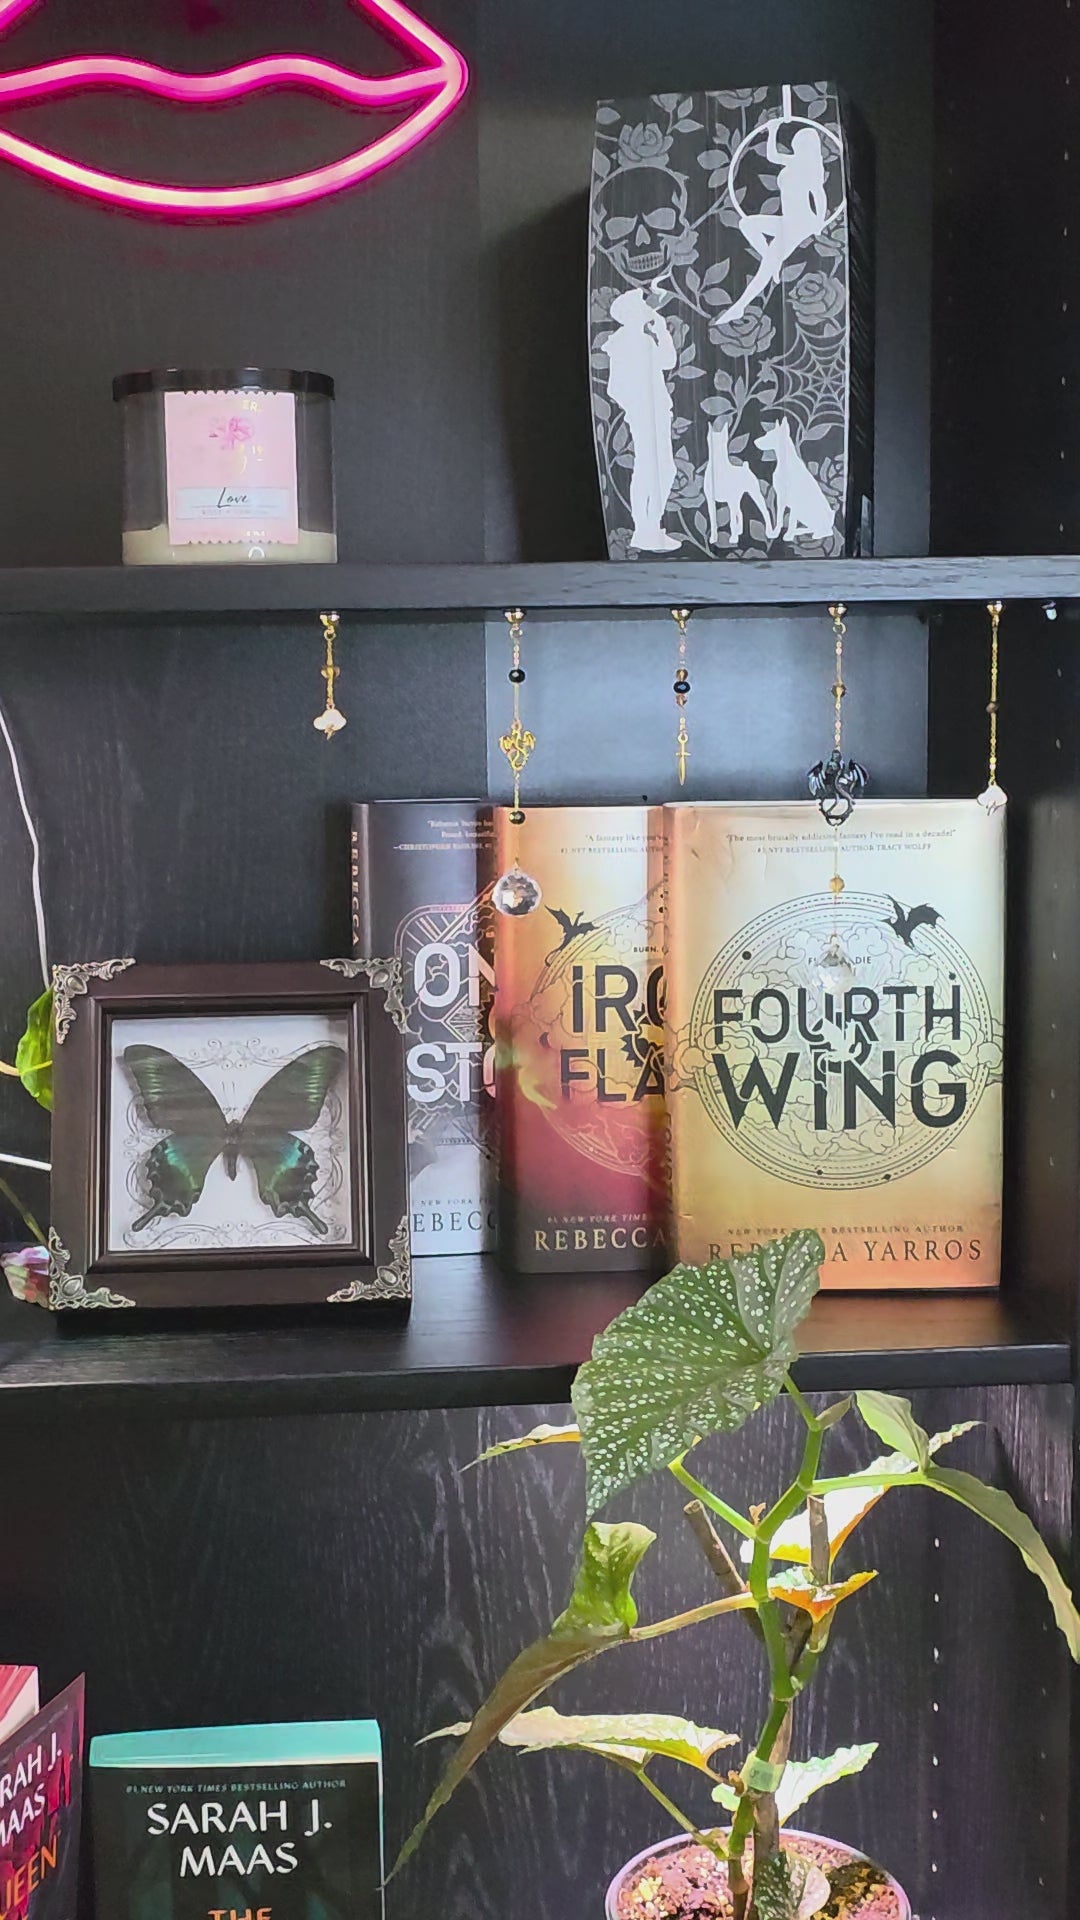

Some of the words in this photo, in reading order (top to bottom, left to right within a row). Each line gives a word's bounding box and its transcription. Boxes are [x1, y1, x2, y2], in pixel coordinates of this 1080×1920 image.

[216, 487, 248, 508] Love
[855, 956, 872, 965] DIE
[713, 985, 962, 1045] FOURTH
[711, 1050, 967, 1131] WING
[589, 1214, 617, 1223] YORK
[831, 1225, 910, 1234] BESTSELLING
[915, 1224, 964, 1233] AUTHOR
[534, 1226, 667, 1251] REBECCA
[727, 1228, 751, 1236] NEW
[757, 1227, 787, 1235] YORK
[863, 1239, 982, 1262] YARROS
[48, 1732, 62, 1772] J.
[140, 1784, 165, 1793] NEW
[166, 1784, 194, 1793] YORK
[198, 1783, 228, 1793] TIMES
[230, 1781, 300, 1792] BESTSELLING
[302, 1779, 347, 1789] AUTHOR
[147, 1800, 288, 1836] SARAH
[304, 1799, 333, 1837] J.
[179, 1842, 299, 1878] MAAS
